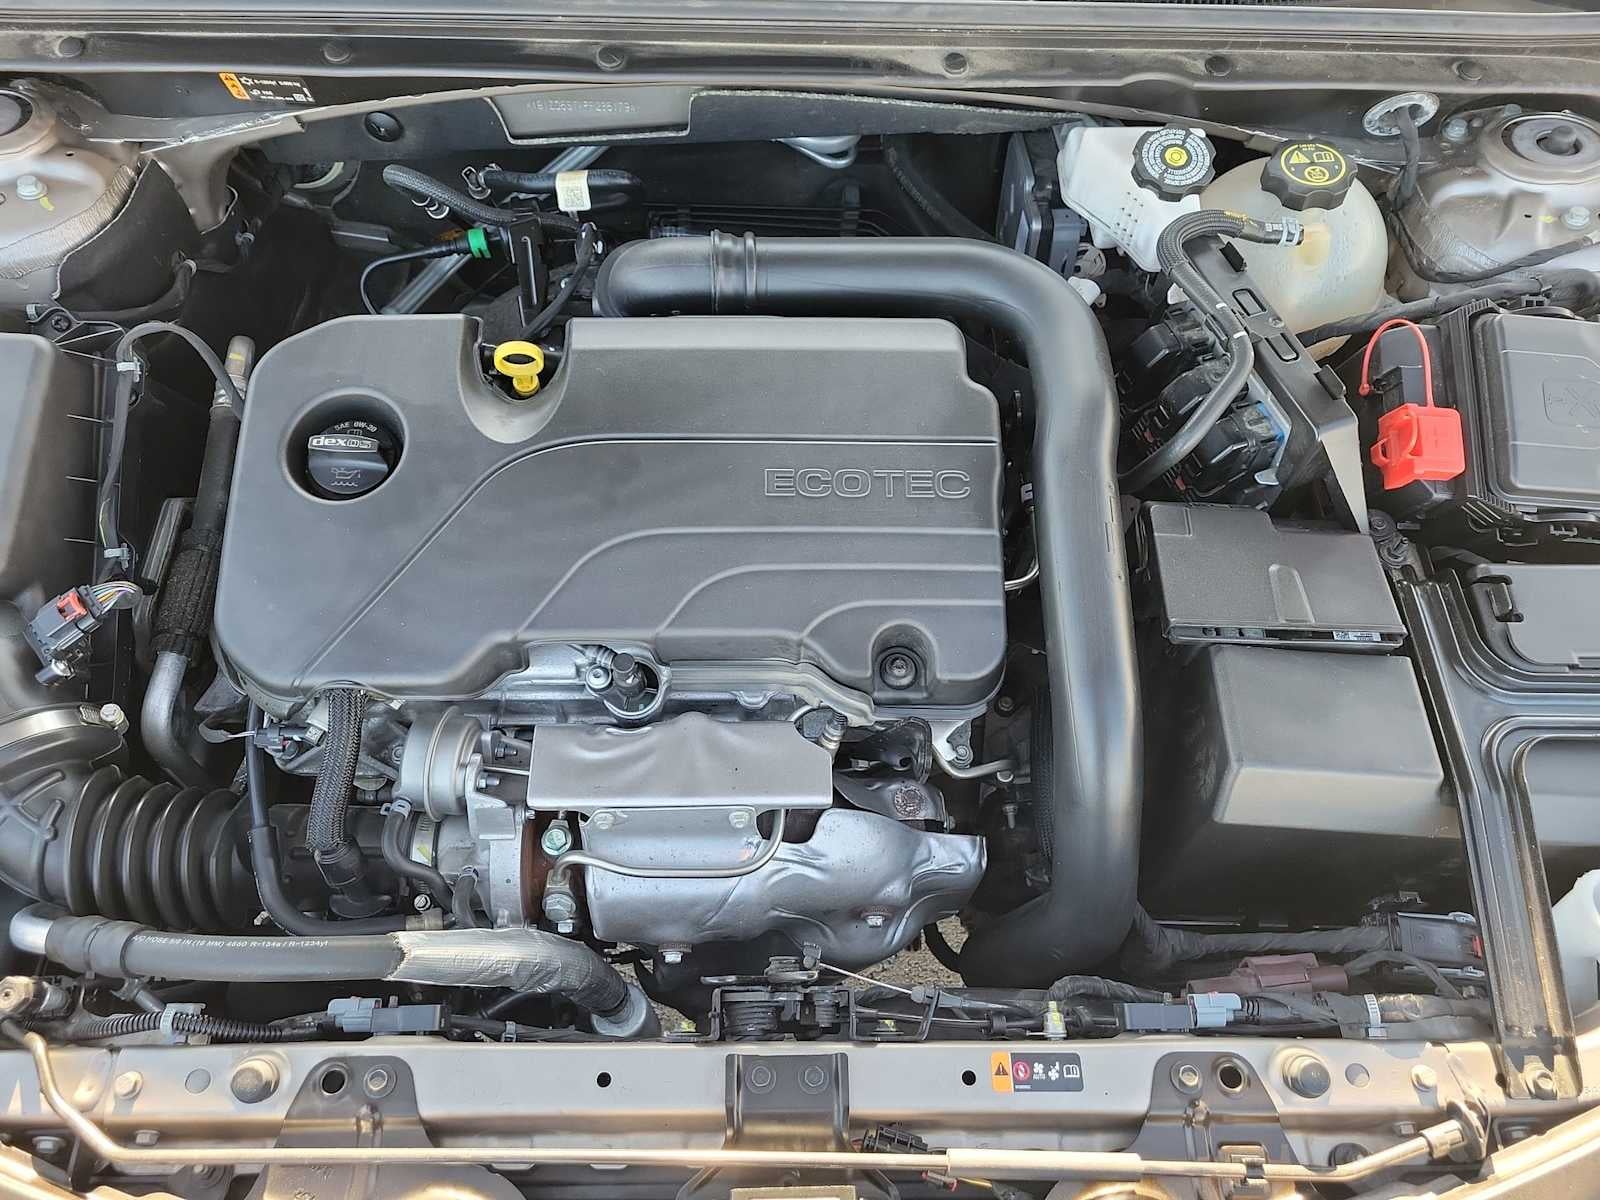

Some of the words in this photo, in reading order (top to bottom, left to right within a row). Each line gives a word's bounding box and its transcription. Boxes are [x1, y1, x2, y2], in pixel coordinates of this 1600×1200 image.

[334, 421, 350, 431] SAE
[764, 468, 971, 499] ECOTEC
[145, 935, 169, 944] HOSE
